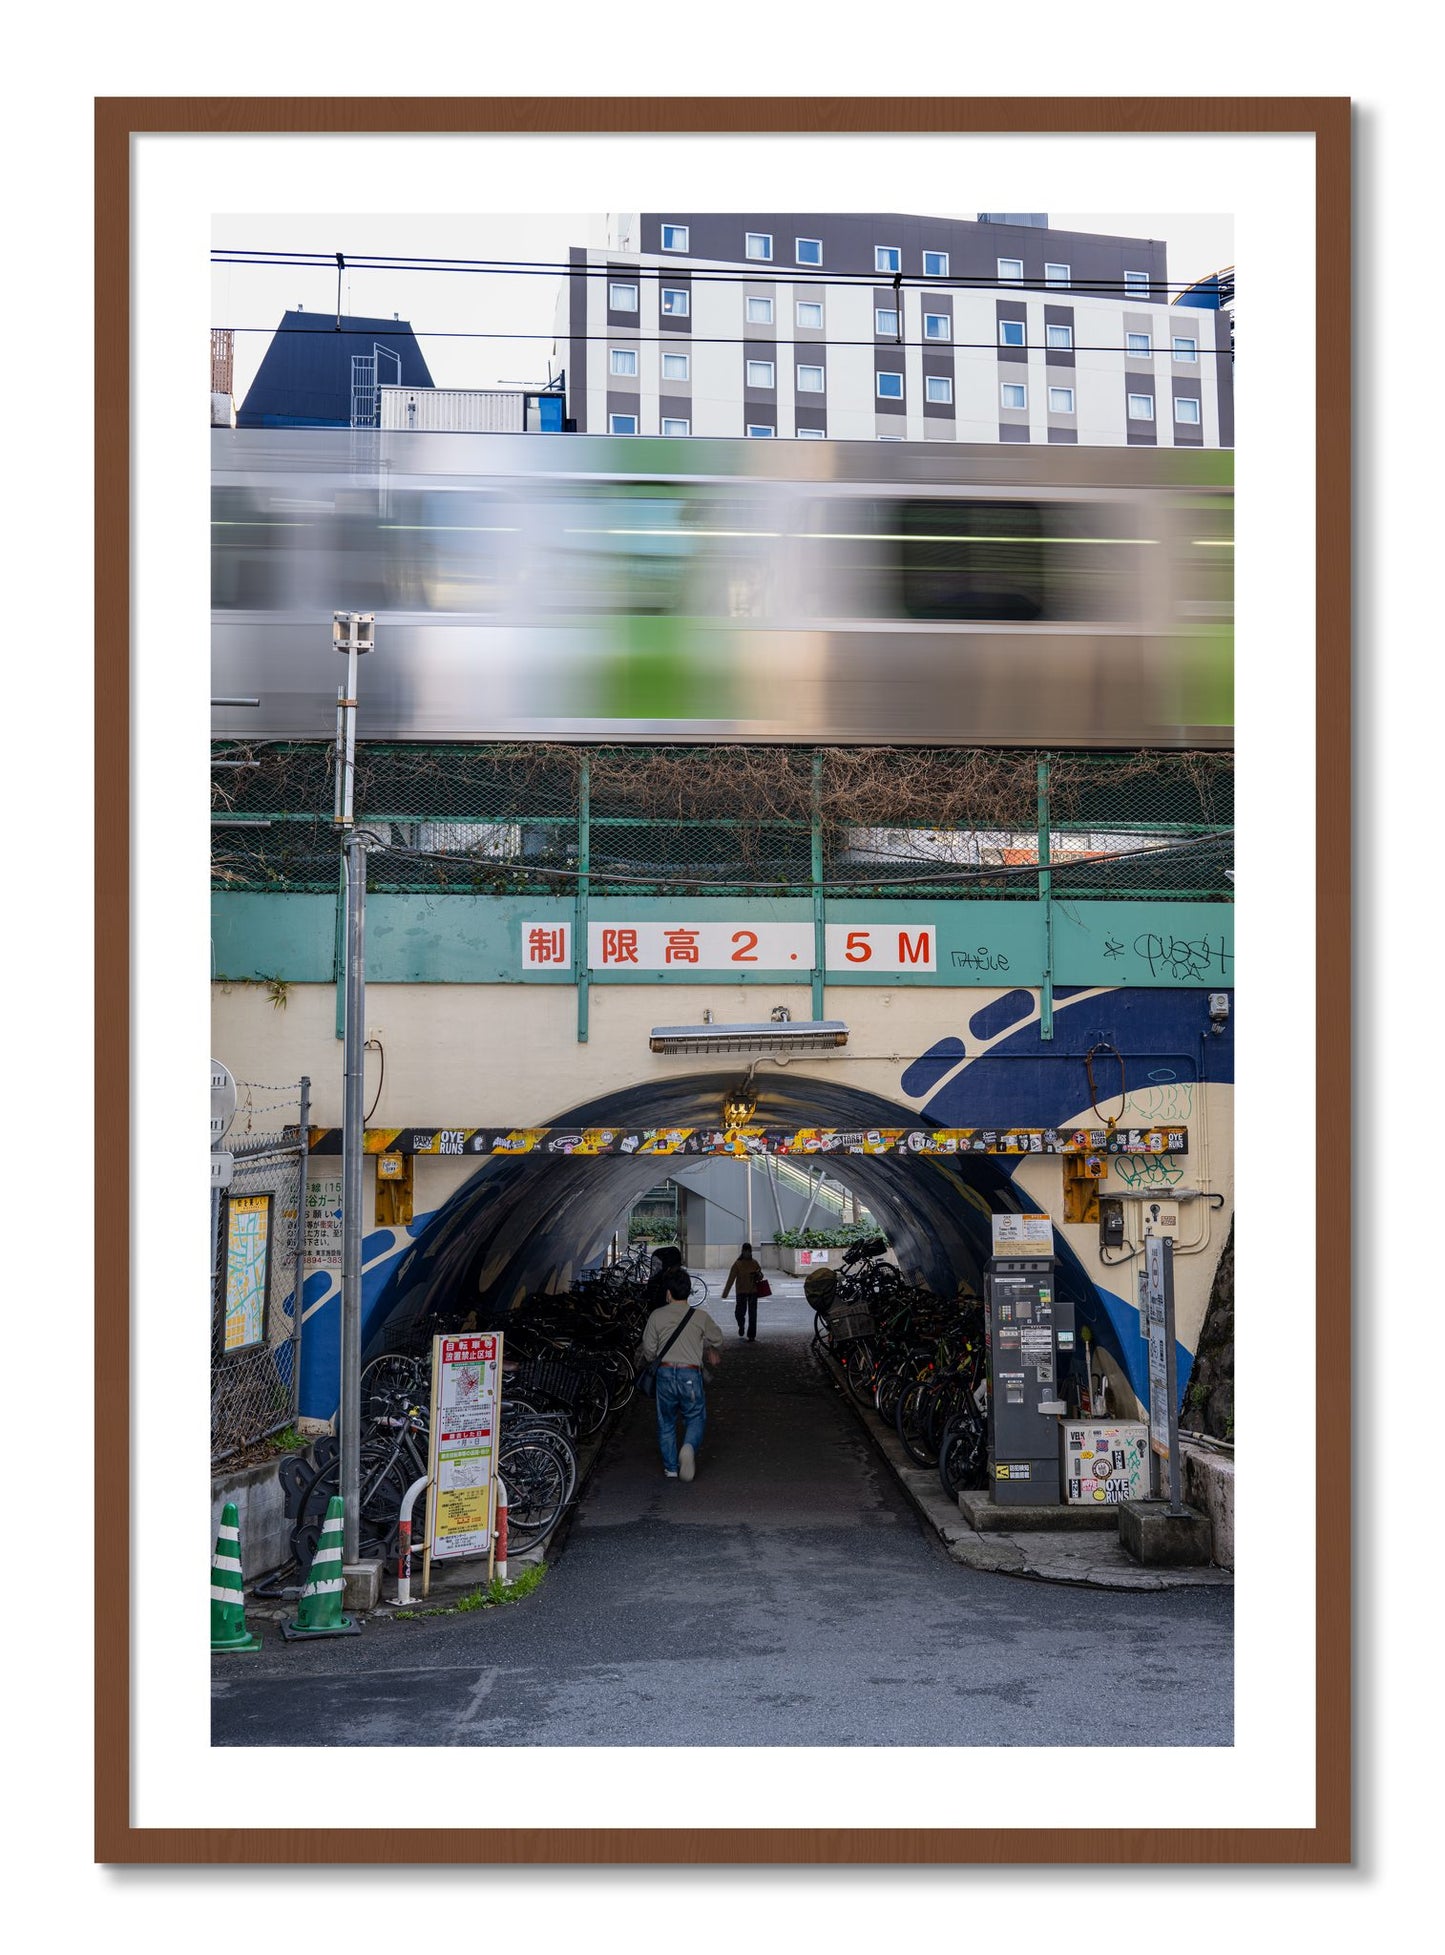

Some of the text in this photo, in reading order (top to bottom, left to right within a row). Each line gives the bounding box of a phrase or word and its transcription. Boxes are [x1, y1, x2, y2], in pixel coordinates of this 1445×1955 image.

[441, 1131, 465, 1143] OYE
[1168, 1133, 1183, 1141] OYE
[440, 1143, 464, 1154] RUNS
[1105, 1480, 1129, 1491] OYE
[1106, 1490, 1129, 1503] RUNS
